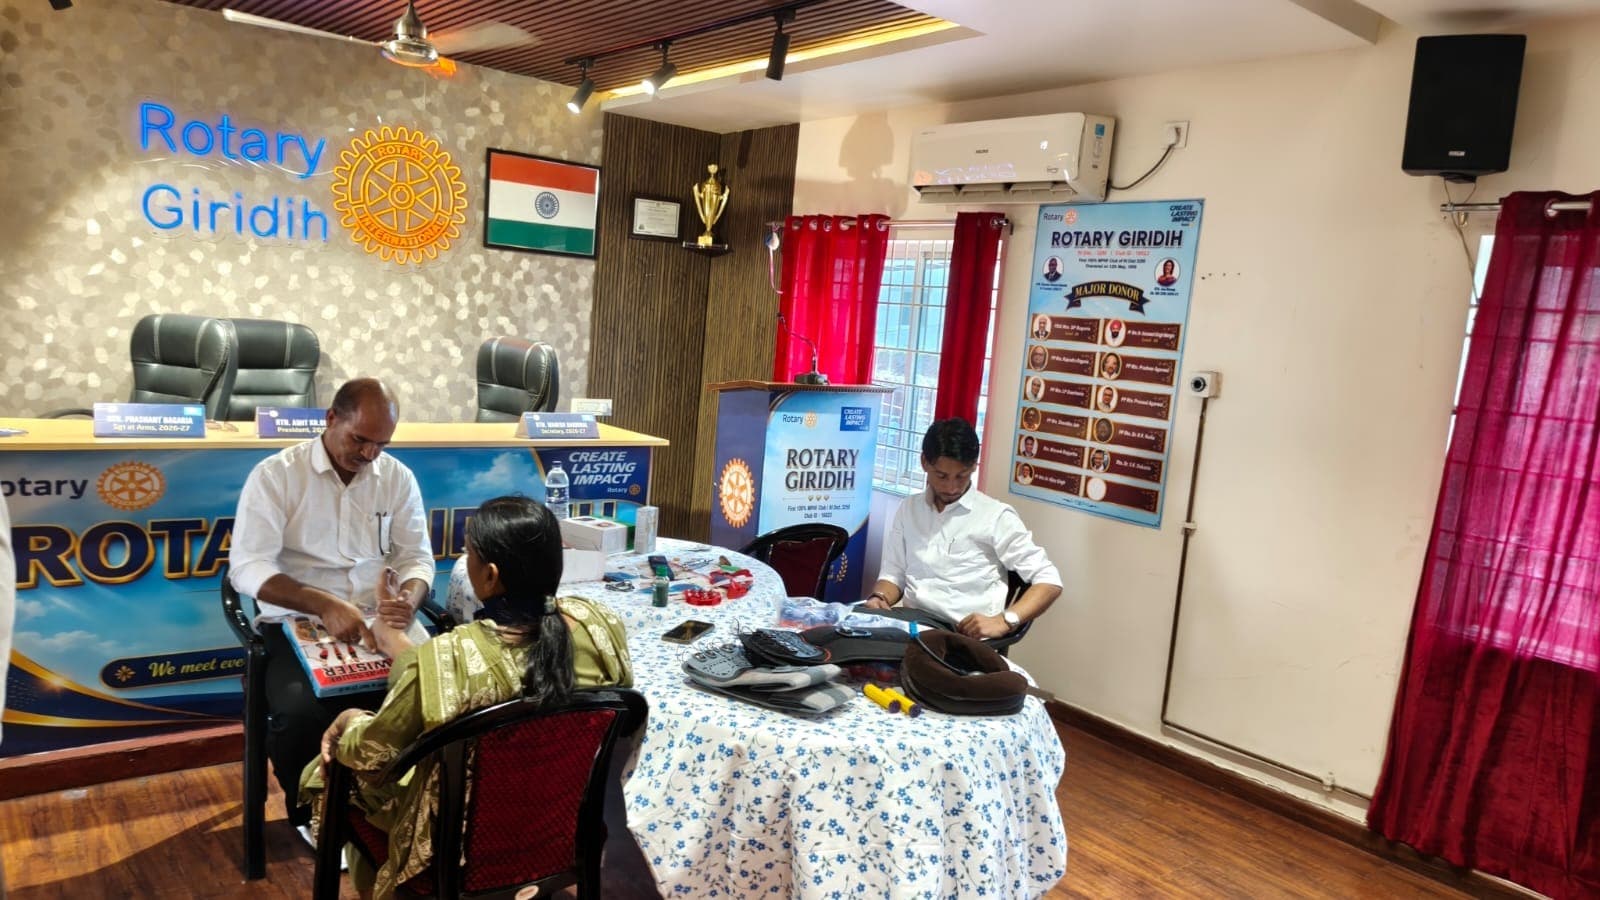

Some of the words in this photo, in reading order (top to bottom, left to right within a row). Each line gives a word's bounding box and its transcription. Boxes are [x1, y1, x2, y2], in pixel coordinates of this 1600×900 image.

[139, 102, 326, 179] Rotary
[377, 145, 428, 162] ROTARY
[142, 184, 328, 242] Giridih
[1043, 212, 1064, 223] Rotary
[358, 212, 447, 247] INTERNATIONAL
[1051, 231, 1115, 247] ROTARY
[1118, 230, 1183, 247] GIRIDIH
[1074, 283, 1107, 296] MAJOR
[1108, 283, 1141, 300] DONOR
[782, 414, 804, 424] Rotary
[569, 451, 627, 462] CREATE
[786, 448, 860, 468] ROTARY
[571, 463, 637, 474] LASTING
[0, 477, 88, 500] otary
[573, 474, 632, 485] IMPACT
[785, 471, 856, 491] GIRIDIH
[607, 487, 628, 495] Rotary
[11, 516, 236, 588] ROTA
[149, 660, 176, 678] We
[180, 658, 216, 674] meet
[219, 657, 245, 670] eve
[324, 658, 394, 677] WISTER
